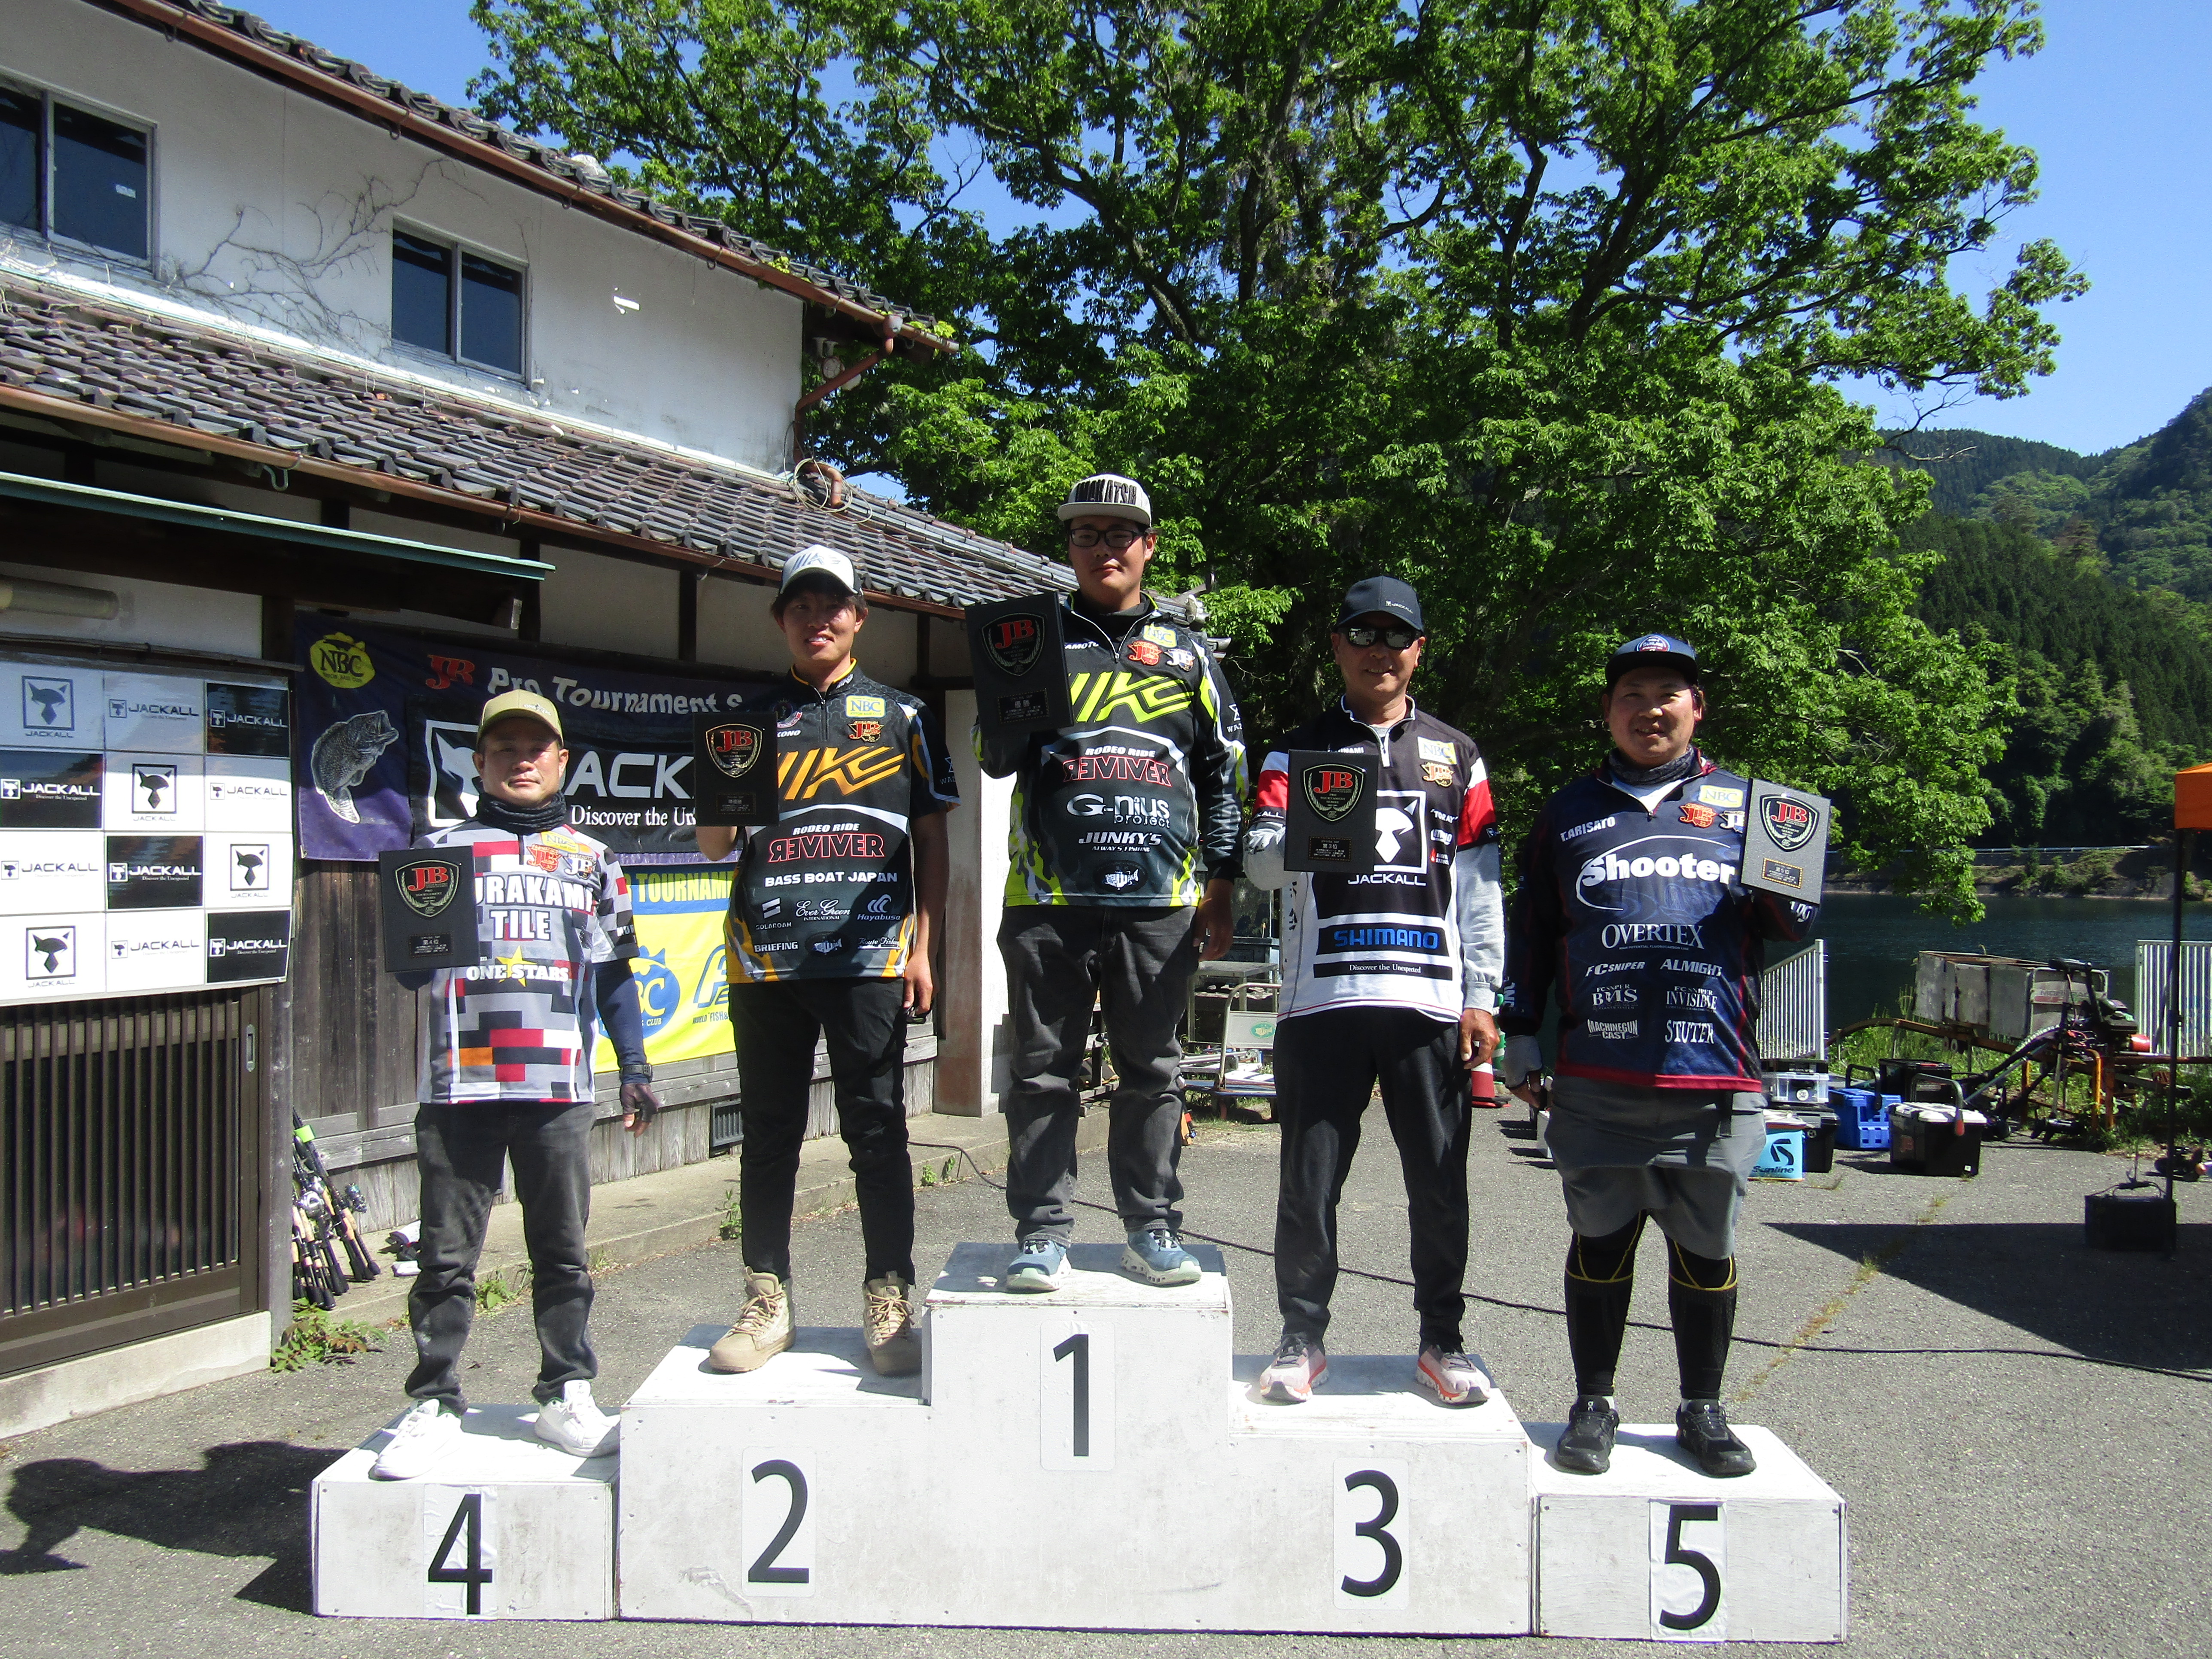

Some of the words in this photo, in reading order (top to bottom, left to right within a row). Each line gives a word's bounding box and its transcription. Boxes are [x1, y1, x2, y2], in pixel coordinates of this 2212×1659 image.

[995, 620, 1035, 649] JB
[1149, 626, 1173, 643] NBC
[319, 647, 364, 678] NBC
[552, 675, 721, 715] Tournament
[128, 703, 199, 716] JACKALL
[850, 699, 881, 712] NBC
[226, 713, 288, 728] JACKALL
[716, 730, 753, 753] JB
[1085, 745, 1126, 756] RODEO
[1127, 747, 1156, 757] RIDE
[1423, 743, 1452, 759] NBC
[22, 783, 101, 796] JACKALL
[1313, 770, 1353, 794] JB
[227, 786, 288, 796] JACKALL
[1705, 790, 1738, 802] NBC
[571, 804, 641, 826] Discover
[645, 806, 668, 826] the
[1770, 800, 1808, 823] JB
[792, 824, 831, 836] RODEO
[832, 823, 860, 833] RIDE
[1113, 815, 1170, 829] project
[1559, 816, 1616, 843] T.ARISATO
[1078, 832, 1162, 845] JUNKY'S
[21, 863, 99, 872] JACKALL
[129, 865, 203, 876] JACKALL
[1581, 852, 1735, 887] Shooter
[407, 866, 449, 892] JB
[636, 870, 734, 902] TOURNAM
[765, 873, 801, 887] BASS
[804, 872, 845, 884] BOAT
[848, 872, 897, 882] JAPAN
[1347, 873, 1427, 887] JACKALL
[489, 909, 551, 941] TILE
[857, 913, 900, 922] Hayabusa
[130, 939, 200, 951] JACKALL
[226, 939, 288, 951] JACKALL
[1334, 928, 1438, 950] SHIMANO
[1601, 923, 1705, 950] OVERTEX
[754, 942, 798, 953] BRIEFING
[466, 965, 507, 981] ONE
[511, 964, 569, 982] STARS
[1392, 964, 1422, 973] Unexpected
[1659, 959, 1723, 977] ALMIGHT
[27, 979, 76, 988] JACKALL
[1666, 991, 1718, 1010] INVISIBLE
[646, 1018, 662, 1026] CLUB
[1587, 1018, 1638, 1036] MACHINEGUN
[1601, 1031, 1626, 1039] CAST
[1052, 1333, 1090, 1457] 1
[747, 1459, 810, 1584] 2
[1341, 1469, 1403, 1598] 3
[428, 1493, 493, 1615] 4
[1659, 1504, 1722, 1631] 5
